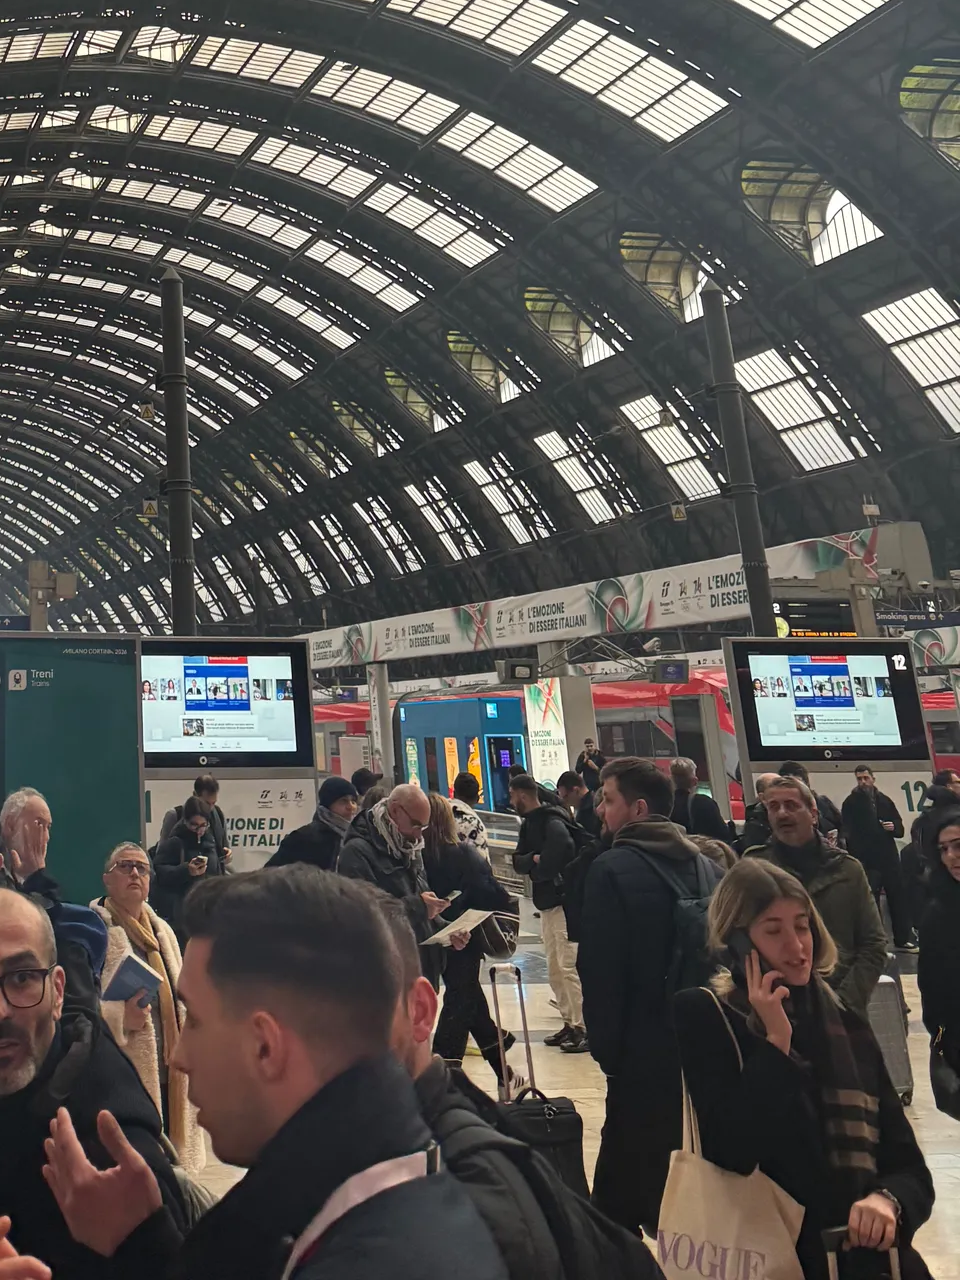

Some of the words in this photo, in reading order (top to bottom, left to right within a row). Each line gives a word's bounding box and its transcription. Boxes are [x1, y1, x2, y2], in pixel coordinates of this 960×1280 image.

[710, 595, 719, 608] DI
[528, 602, 565, 618] L'EMOZIONE
[529, 621, 535, 633] DI
[536, 618, 558, 632] ESSERE
[559, 614, 587, 629] ITALIANI
[876, 613, 908, 621] Smoking
[408, 623, 435, 636] L'EMOZIONE
[415, 636, 431, 647] ESSERE
[431, 634, 450, 646] ITALIANI
[892, 655, 907, 670] 12
[31, 669, 54, 678] Treni
[901, 781, 929, 811] 12
[269, 818, 284, 830] DI
[657, 1229, 765, 1280] VOGUE
